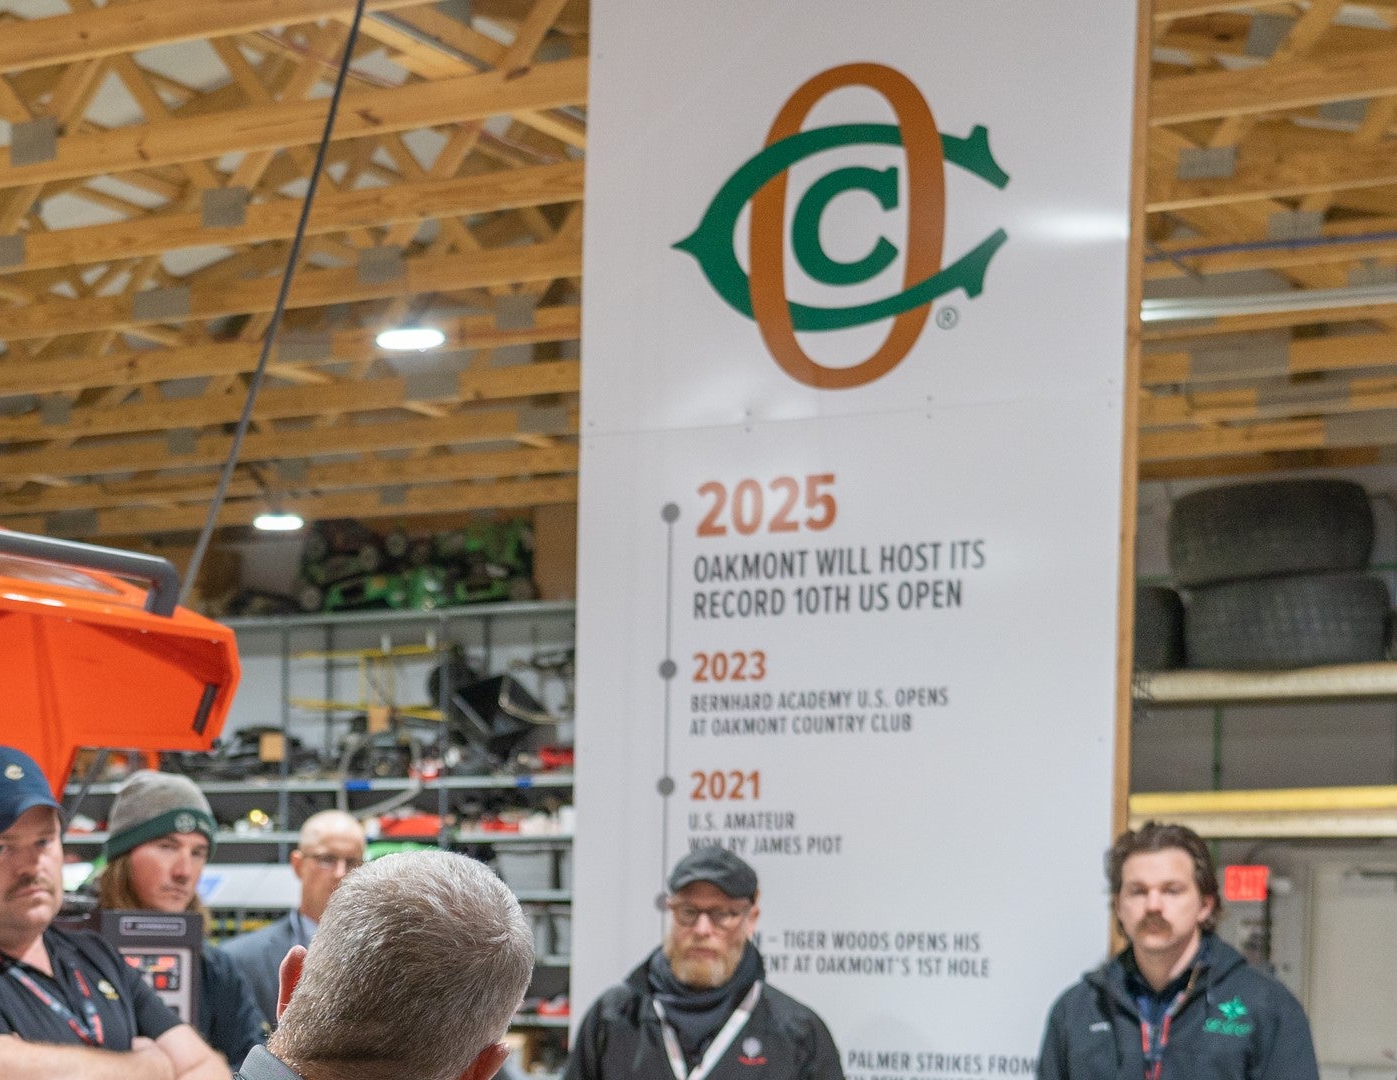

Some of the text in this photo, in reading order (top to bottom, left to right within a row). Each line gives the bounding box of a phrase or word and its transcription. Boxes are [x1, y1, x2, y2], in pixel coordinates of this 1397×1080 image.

[696, 473, 837, 538] 2025
[694, 540, 987, 583] OAKMONT WILL HOST ITS
[693, 580, 962, 619] RECORD 10TH US OPEN
[692, 651, 767, 683] 2023
[691, 687, 949, 713] BERNHARD ACADEMY U.S. OPENS
[690, 713, 913, 736] AT OAKMONT COUNTRY CLUB
[690, 770, 760, 800] 2021
[689, 812, 795, 831] U.S. AMATEUR
[729, 836, 747, 852] BY
[754, 836, 801, 855] JAMES
[807, 835, 842, 854] PIOT
[784, 931, 826, 949] TIGER
[832, 931, 889, 950] WOODS
[895, 933, 947, 950] OPENS
[954, 933, 980, 950] HIS
[793, 954, 810, 973] AT
[816, 956, 911, 976] OAKMONT'S
[917, 957, 942, 976] 1ST
[948, 958, 990, 978] HOLE
[848, 1050, 1037, 1075] PALMER STRIKES FROM
